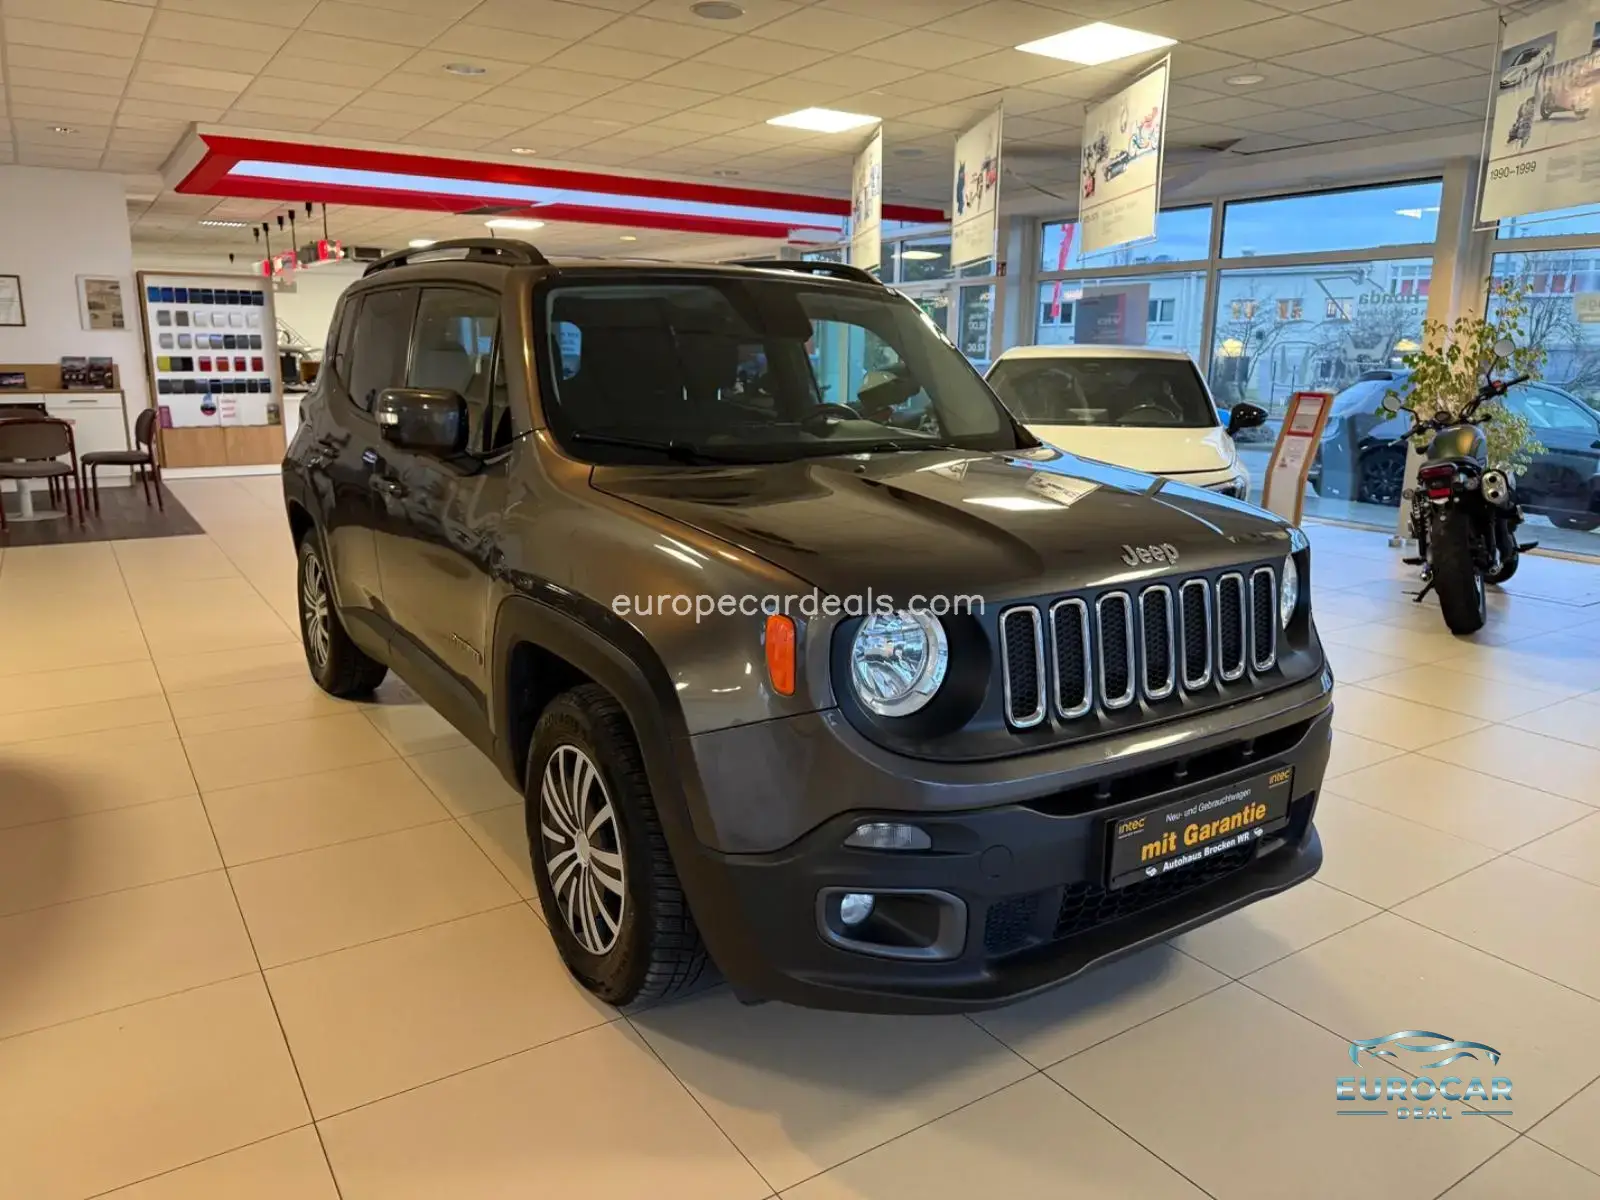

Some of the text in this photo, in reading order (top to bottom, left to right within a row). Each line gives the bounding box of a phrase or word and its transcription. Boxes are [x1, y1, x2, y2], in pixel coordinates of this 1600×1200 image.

[1120, 542, 1179, 566] Jeep
[1268, 768, 1291, 785] intec
[1165, 787, 1252, 823] Neu- und Gebrauchtwagen
[1118, 816, 1146, 834] intec
[1141, 802, 1267, 862] mit Garantie
[1162, 832, 1250, 873] Autohaus Brocken WR
